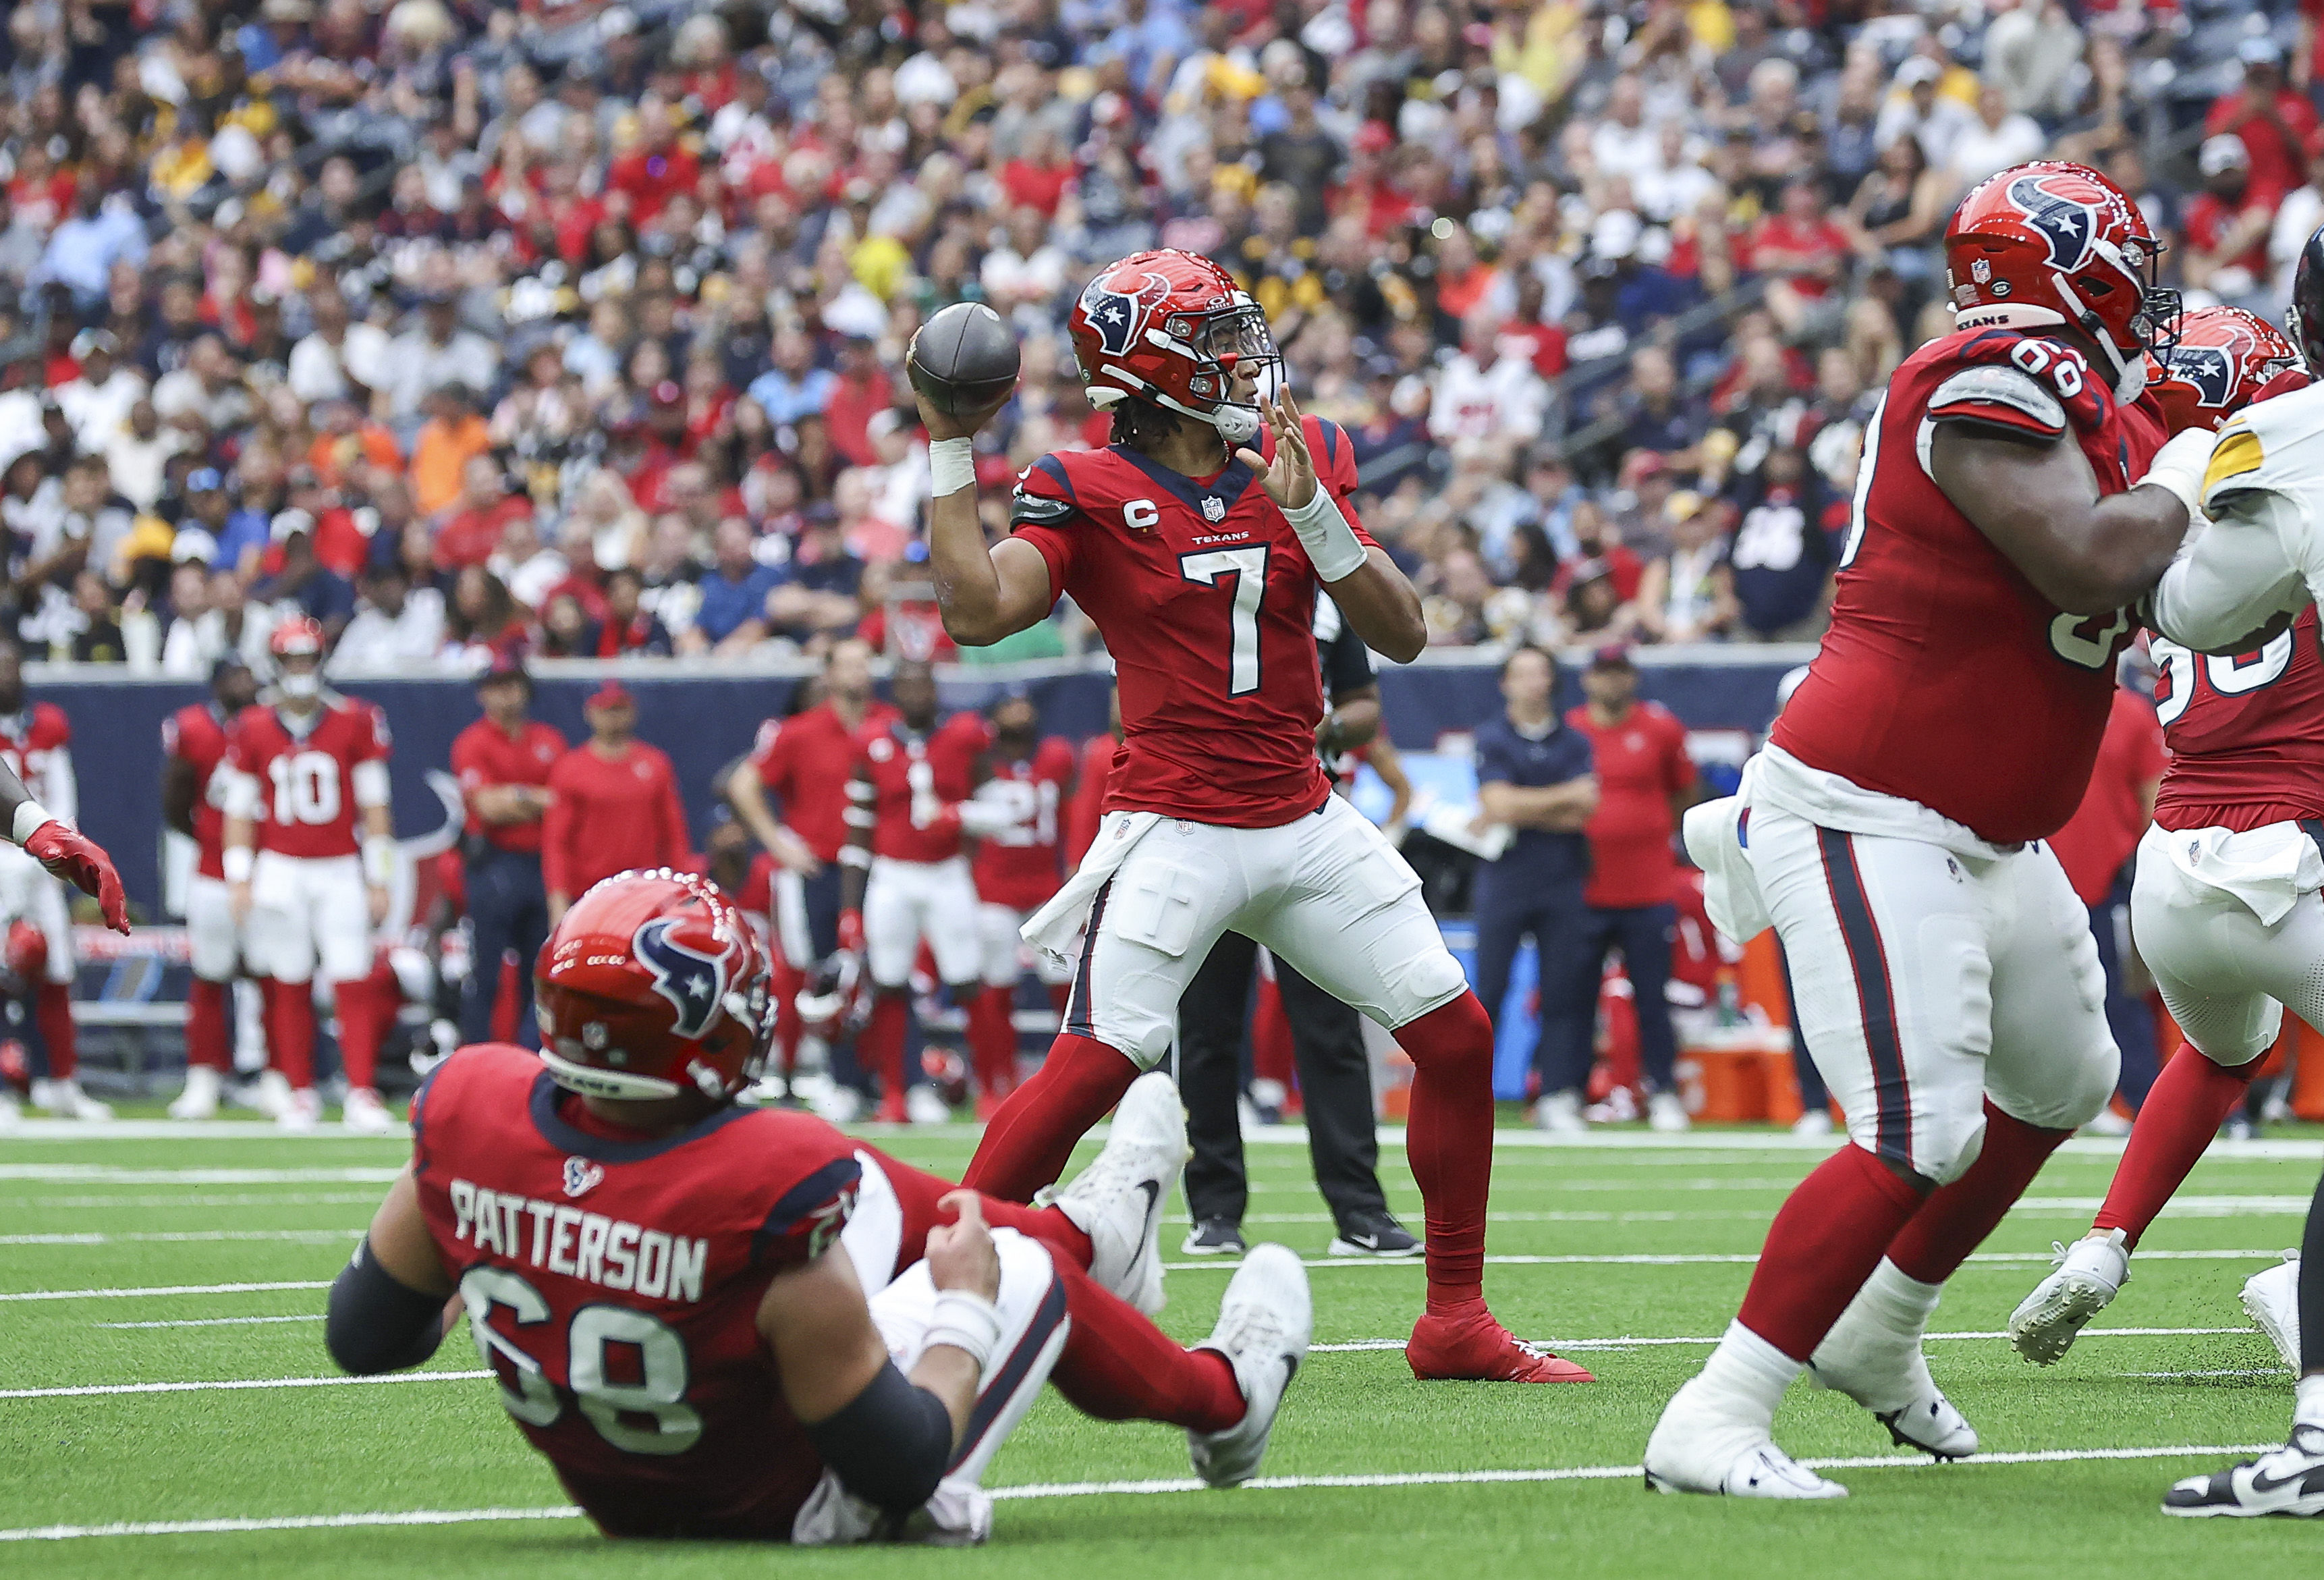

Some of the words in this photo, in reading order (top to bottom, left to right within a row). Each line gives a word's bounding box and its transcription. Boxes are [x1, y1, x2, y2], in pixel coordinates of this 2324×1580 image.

[1123, 499, 1159, 529] C
[1192, 530, 1250, 545] TEXANS
[1178, 543, 1269, 697] 7
[268, 750, 341, 826] 10
[450, 1177, 709, 1304] PATTERSON
[459, 1265, 703, 1456] 68
